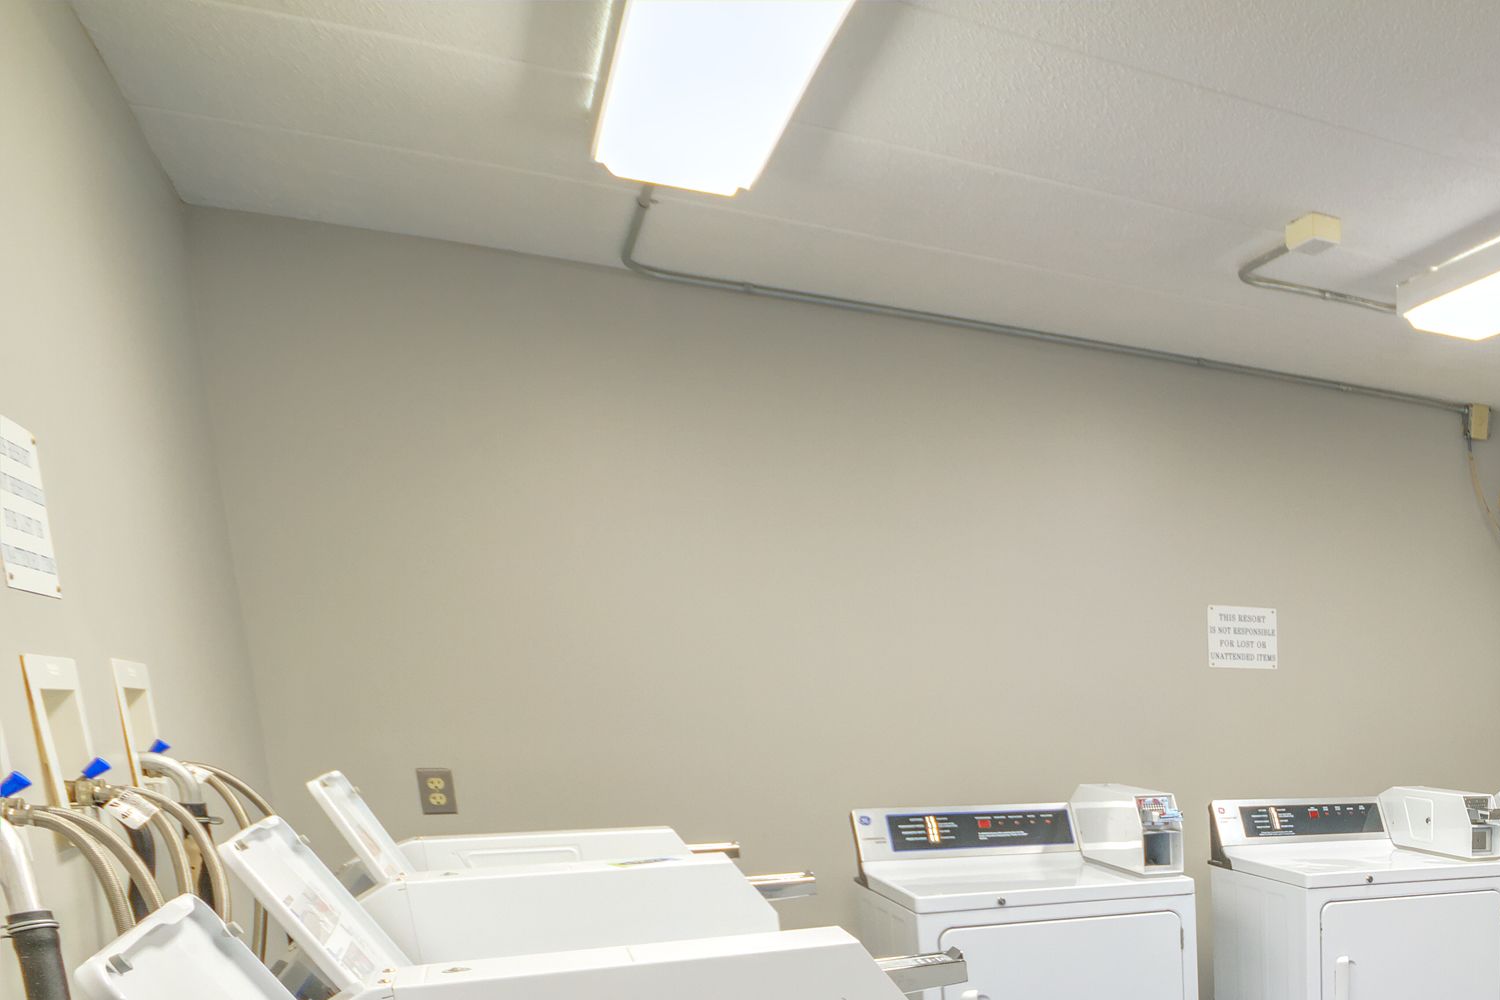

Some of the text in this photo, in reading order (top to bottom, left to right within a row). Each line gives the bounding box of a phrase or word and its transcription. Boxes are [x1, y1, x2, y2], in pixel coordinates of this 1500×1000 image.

[1219, 613, 1266, 623] THIS RESORT
[1209, 625, 1276, 636] IS NOT RESPONSIBLE
[1219, 640, 1234, 648] FOR
[1236, 640, 1254, 648] LOST
[1210, 652, 1276, 662] UNATTENDED ITEMS
